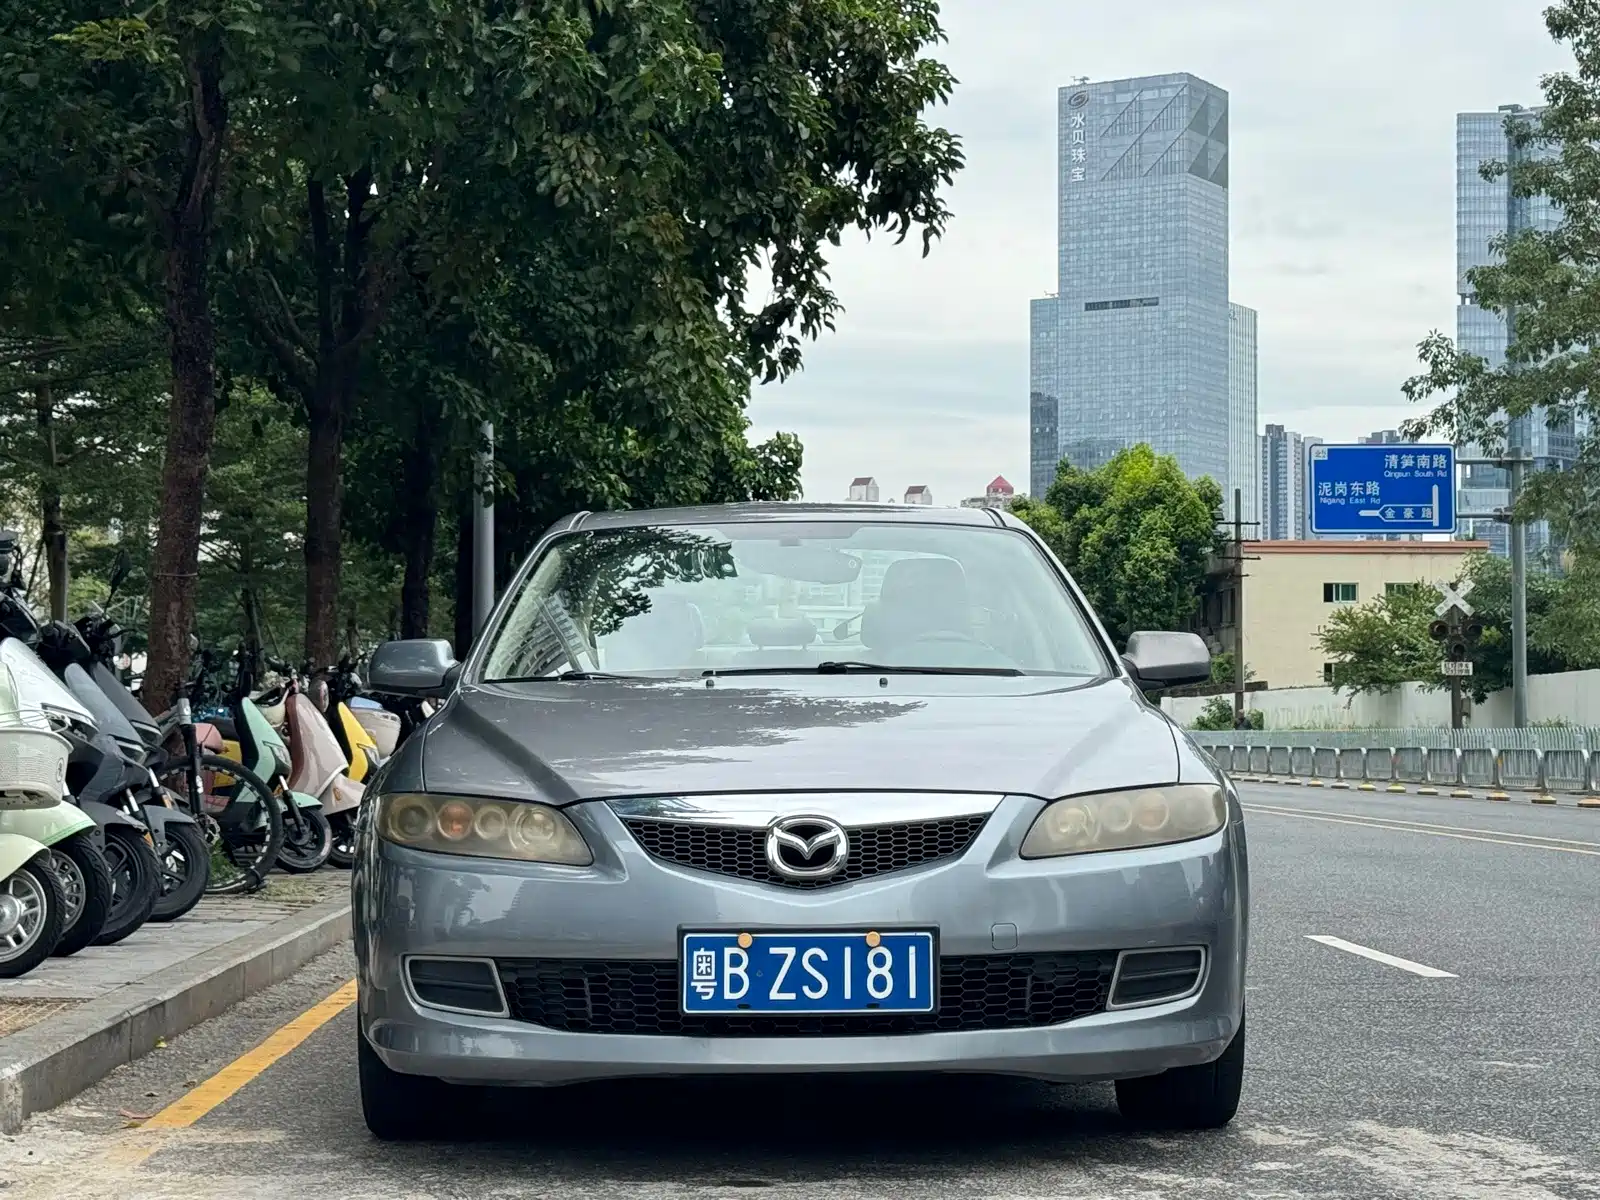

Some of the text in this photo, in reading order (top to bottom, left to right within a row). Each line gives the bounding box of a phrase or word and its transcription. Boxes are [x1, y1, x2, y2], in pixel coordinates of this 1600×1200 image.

[1070, 112, 1087, 183] 水贝珠宝
[1384, 454, 1448, 469] 清笋南路
[1384, 470, 1448, 479] Qingsun South Rd
[1318, 481, 1380, 497] 泥岗东路
[1320, 497, 1345, 505] Nigang
[1385, 507, 1433, 519] 金豪路
[768, 945, 917, 1000] ZS181
